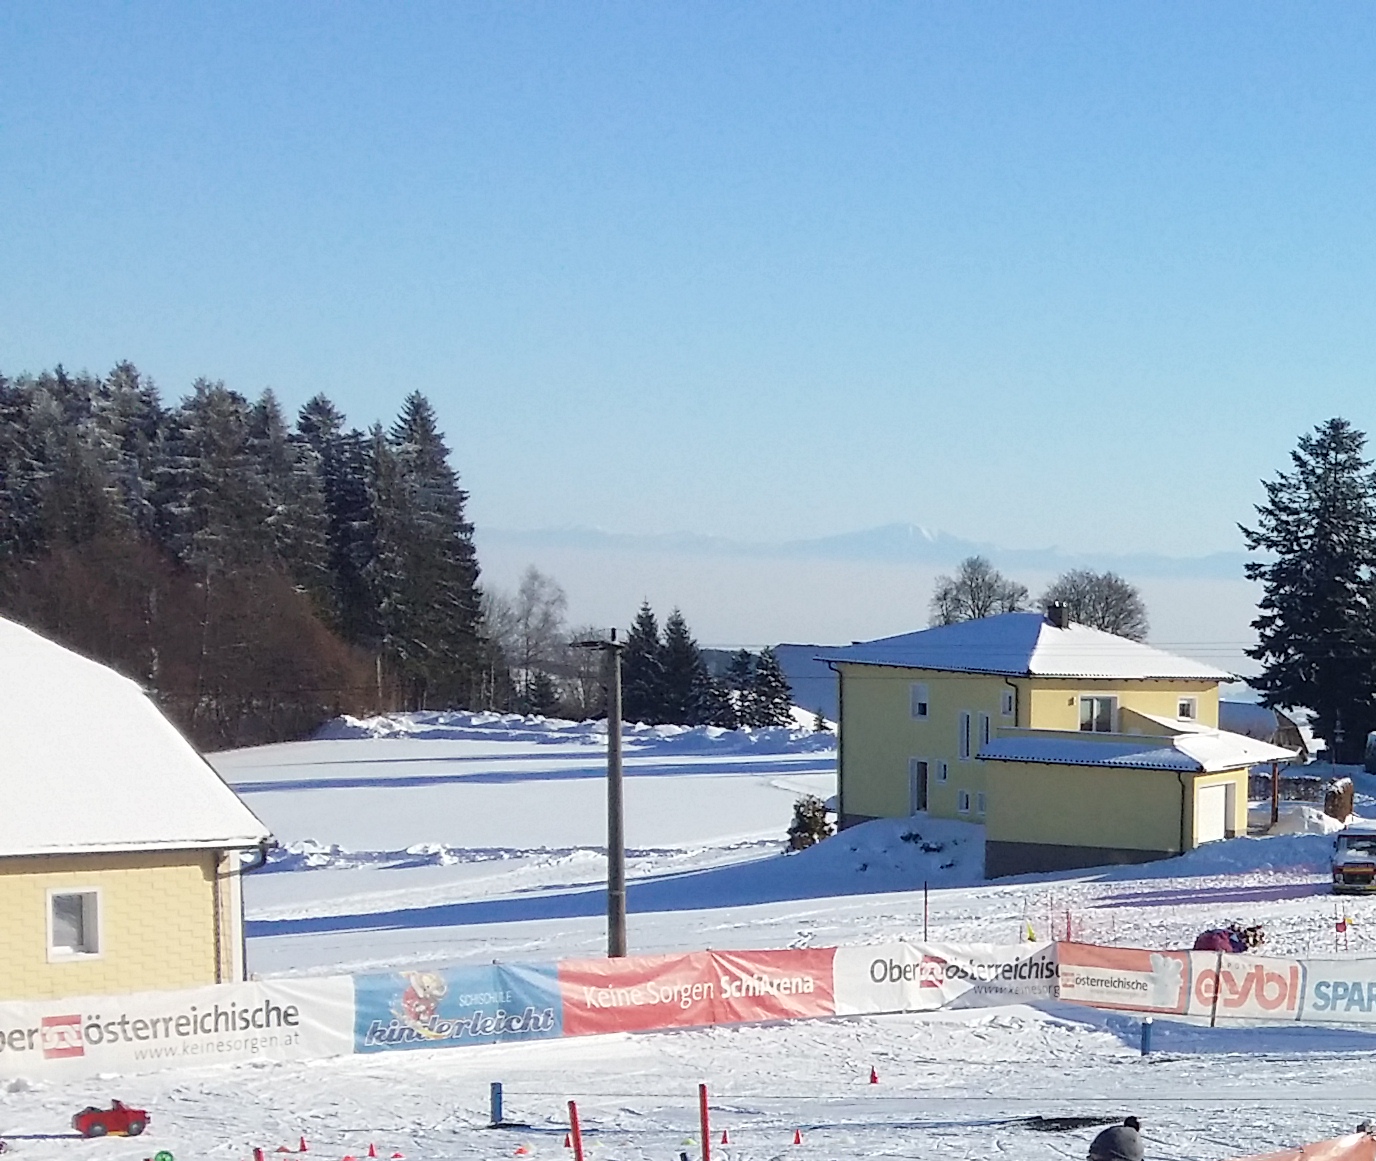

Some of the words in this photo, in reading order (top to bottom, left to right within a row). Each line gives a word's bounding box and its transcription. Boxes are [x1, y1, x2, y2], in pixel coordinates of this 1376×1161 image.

[870, 957, 919, 984] Ober
[1075, 975, 1148, 991] österreichische
[1195, 964, 1299, 1012] eybl
[584, 984, 644, 1010] Keine
[646, 980, 714, 1010] Sorgen
[720, 974, 814, 999] SchiArena
[84, 999, 300, 1046] österreichische
[365, 1006, 555, 1047] kinderleicht
[134, 1030, 300, 1061] www.keinesorgen.at
